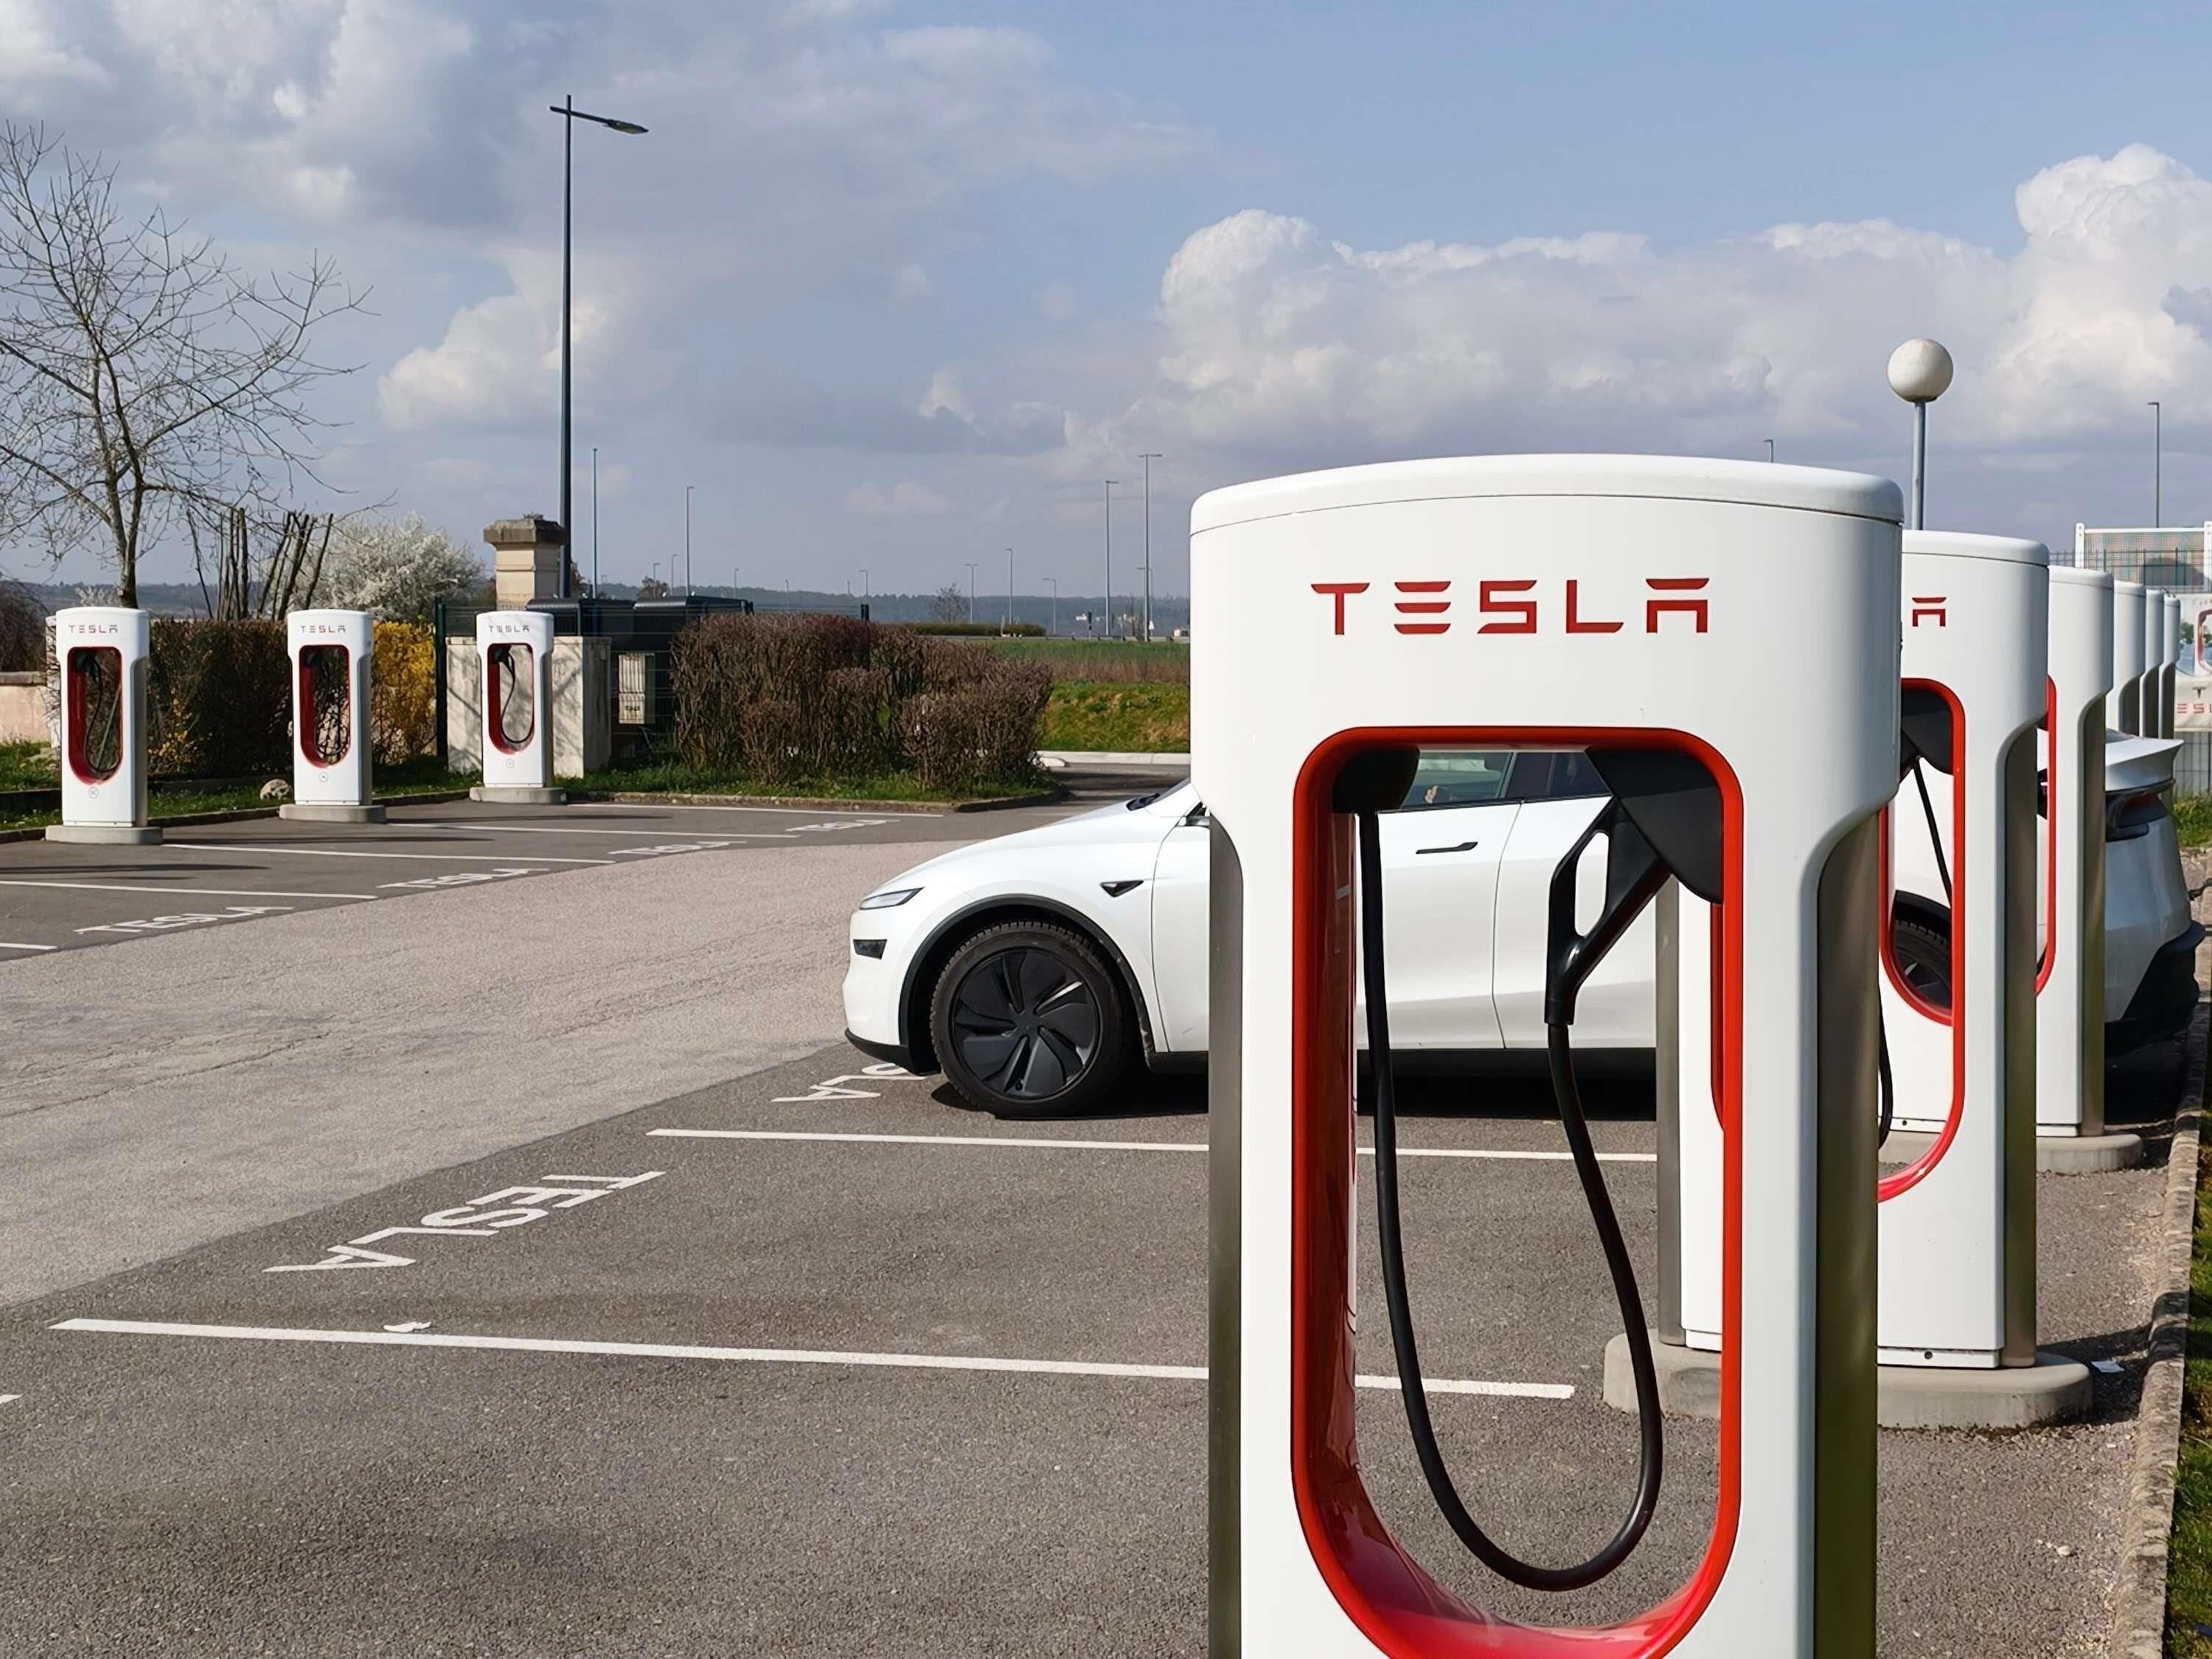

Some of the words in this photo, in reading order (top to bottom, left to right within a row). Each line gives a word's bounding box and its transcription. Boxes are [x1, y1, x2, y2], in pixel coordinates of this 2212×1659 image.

[1311, 578, 1710, 636] TESLA
[69, 625, 118, 633] TESLA
[300, 625, 346, 633] TESLA
[489, 625, 530, 633] TESLA
[73, 906, 294, 933] TESLA
[262, 1170, 667, 1273] TESLA
